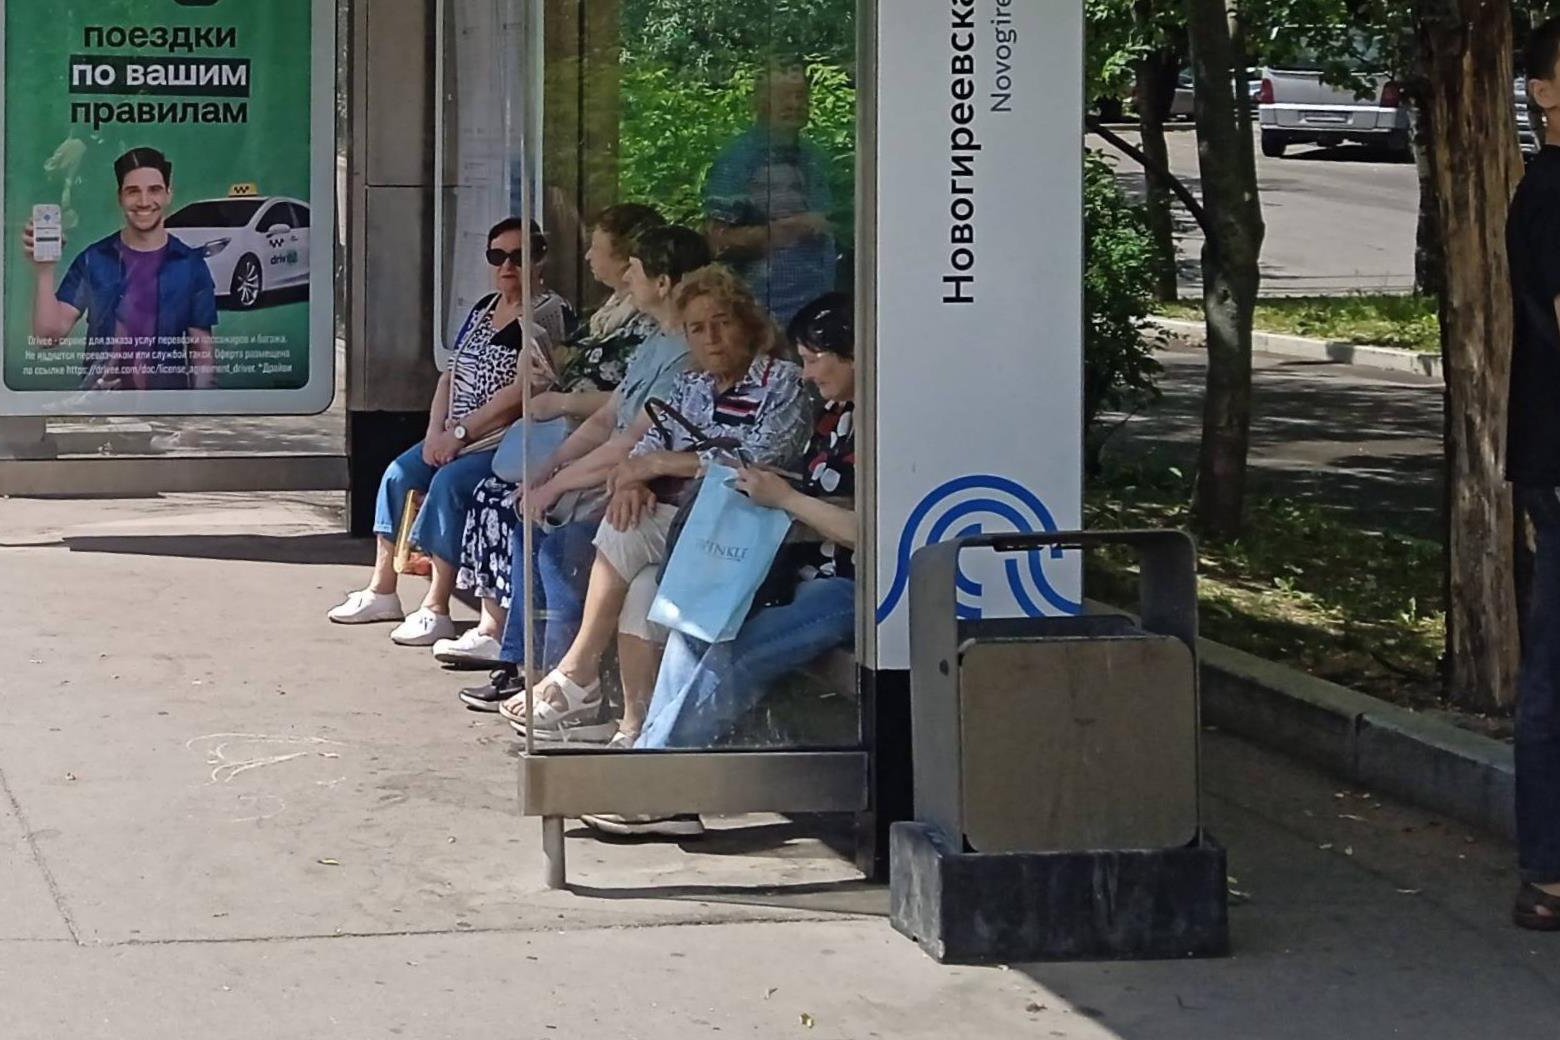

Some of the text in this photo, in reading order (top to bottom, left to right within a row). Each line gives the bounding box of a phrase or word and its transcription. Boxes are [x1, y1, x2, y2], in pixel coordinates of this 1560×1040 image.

[83, 25, 237, 53] поездки
[72, 63, 248, 87] по вашим
[70, 101, 249, 131] правилам
